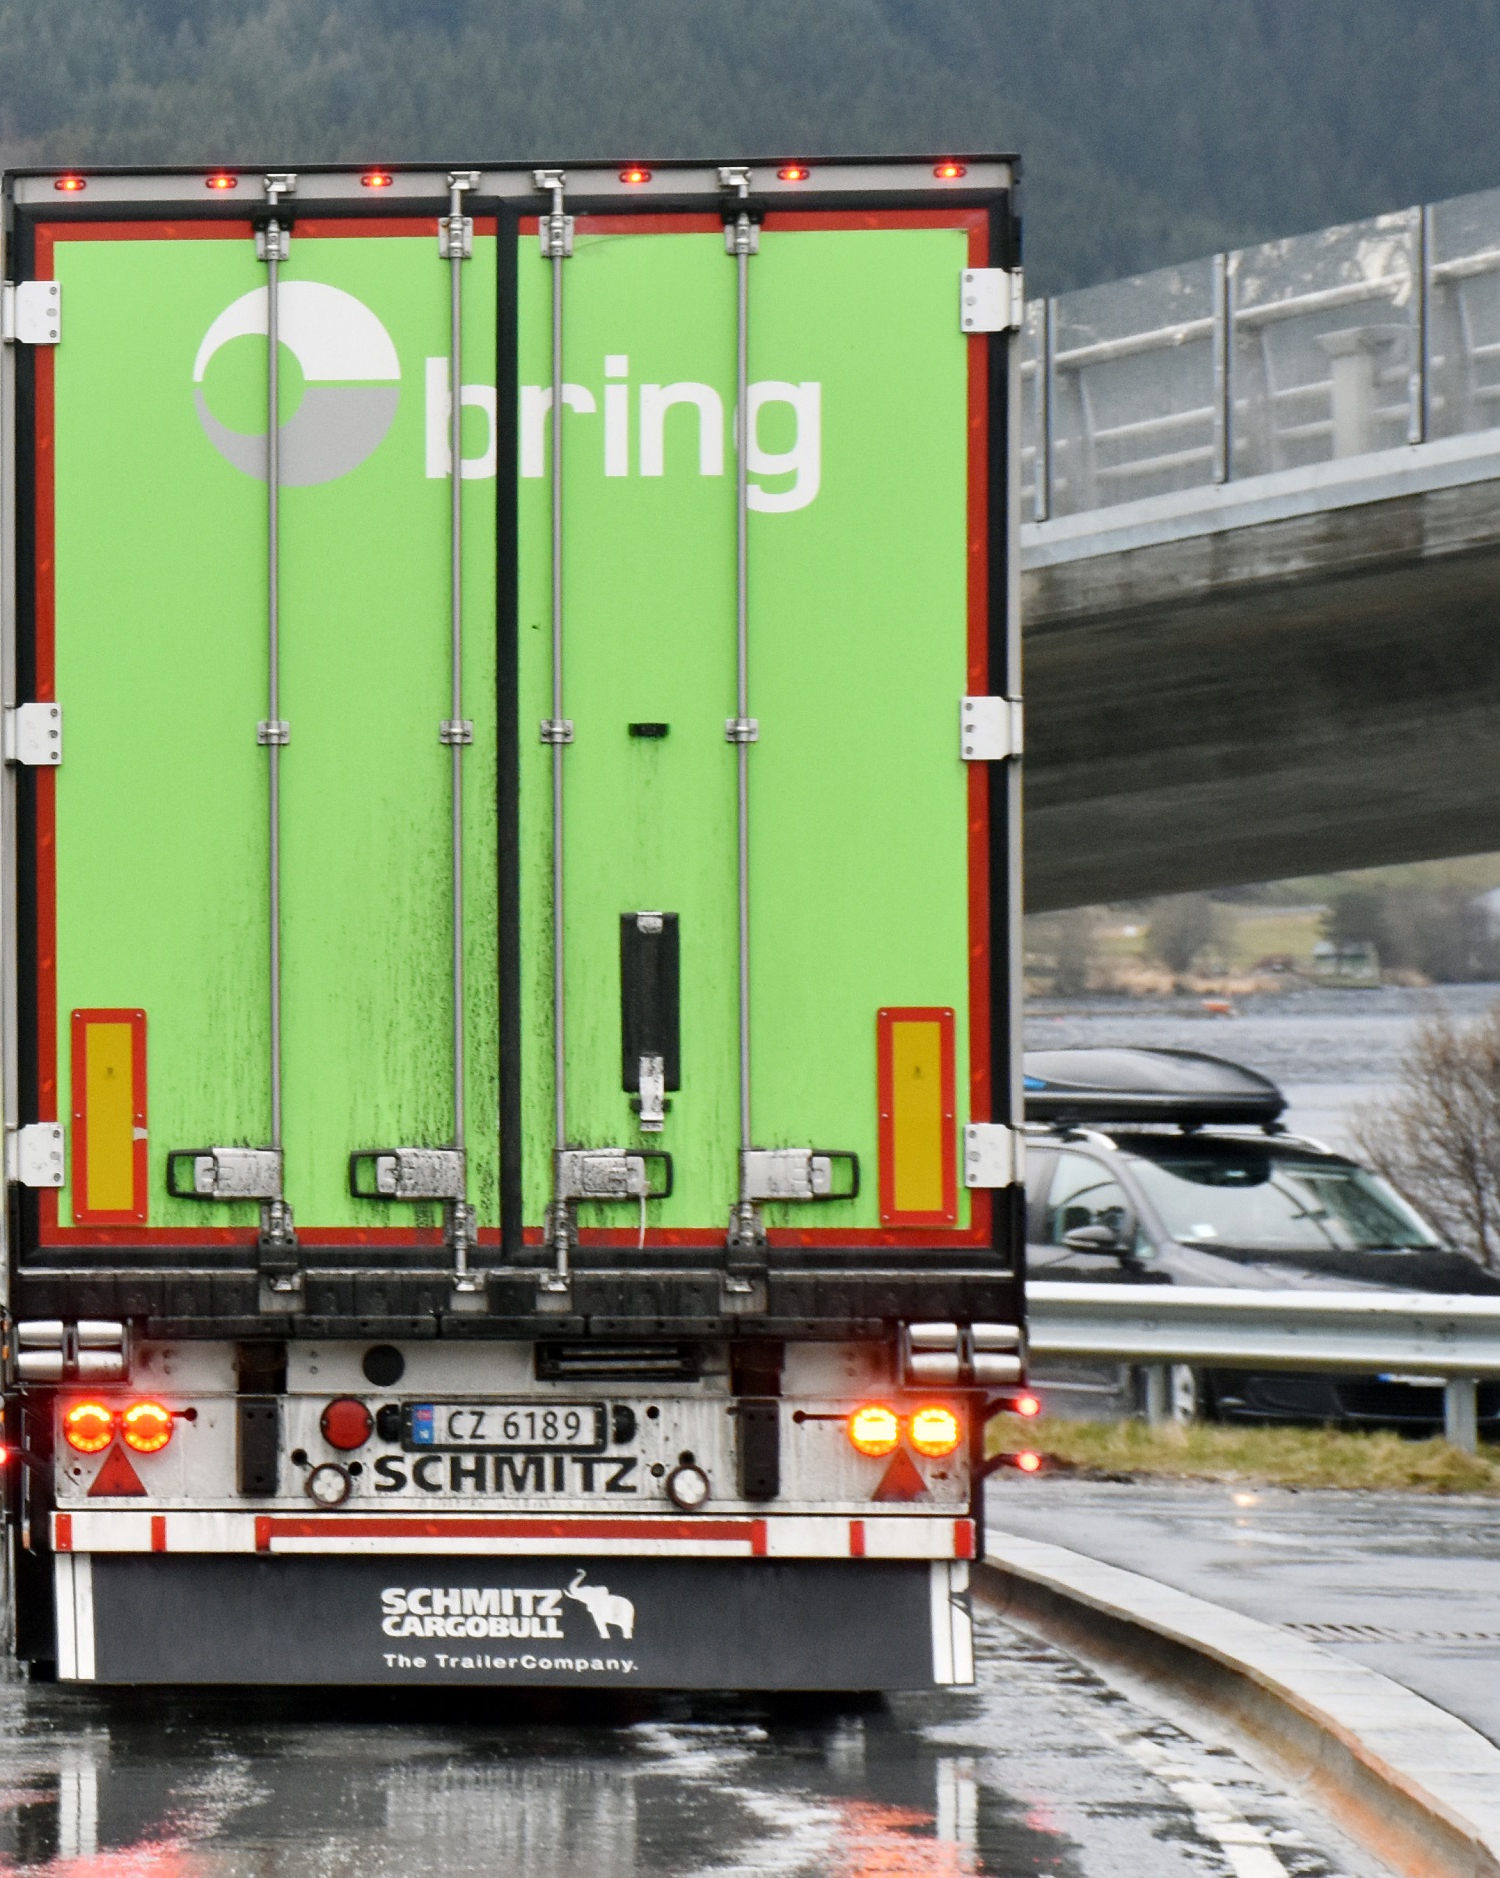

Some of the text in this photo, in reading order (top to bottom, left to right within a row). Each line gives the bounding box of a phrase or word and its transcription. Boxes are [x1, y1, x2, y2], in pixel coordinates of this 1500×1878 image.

[425, 354, 821, 513] bring
[448, 1410, 580, 1441] CZ 6189
[373, 1454, 638, 1493] SCHMITZ
[380, 1587, 563, 1616] SCHMITZ
[381, 1616, 564, 1639] CARGOBULL
[382, 1653, 427, 1669] The
